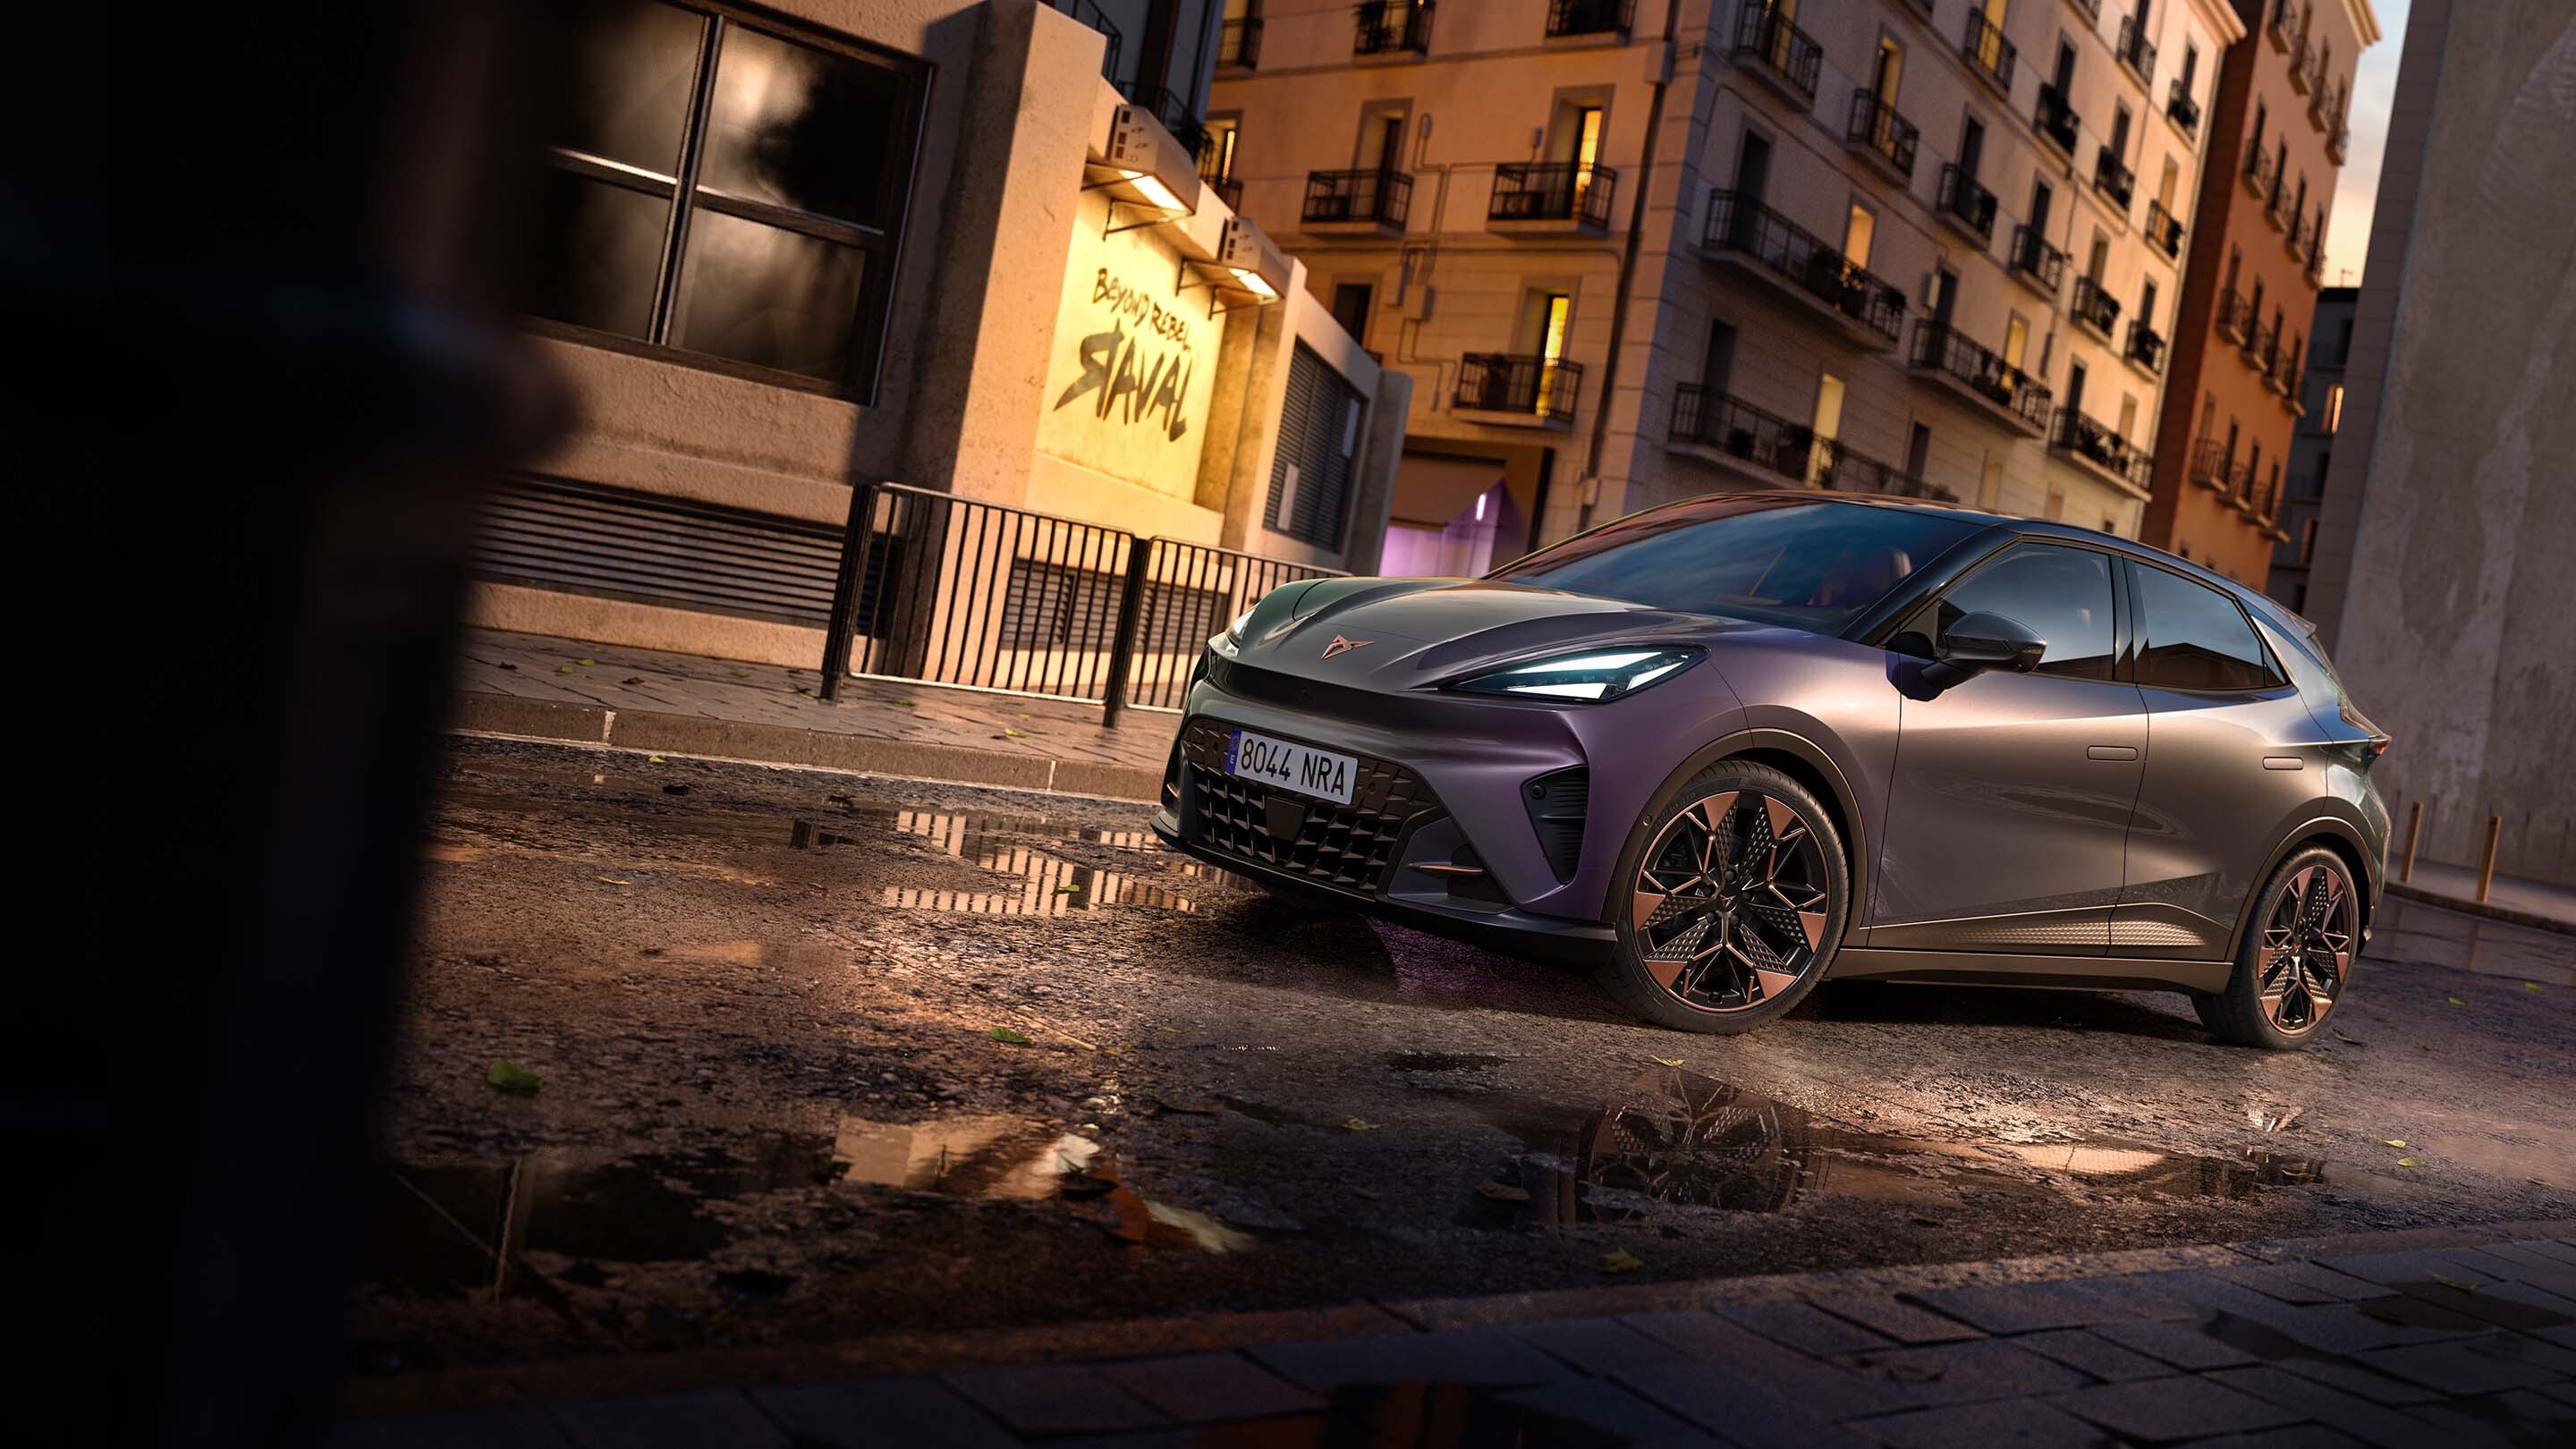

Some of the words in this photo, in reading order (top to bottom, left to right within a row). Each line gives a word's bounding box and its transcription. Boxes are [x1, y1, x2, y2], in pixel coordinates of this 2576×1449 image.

[1093, 267, 1150, 327] BEYOND
[1149, 301, 1191, 352] REBEL
[1241, 738, 1292, 782] 8044
[1301, 752, 1345, 796] NRA
